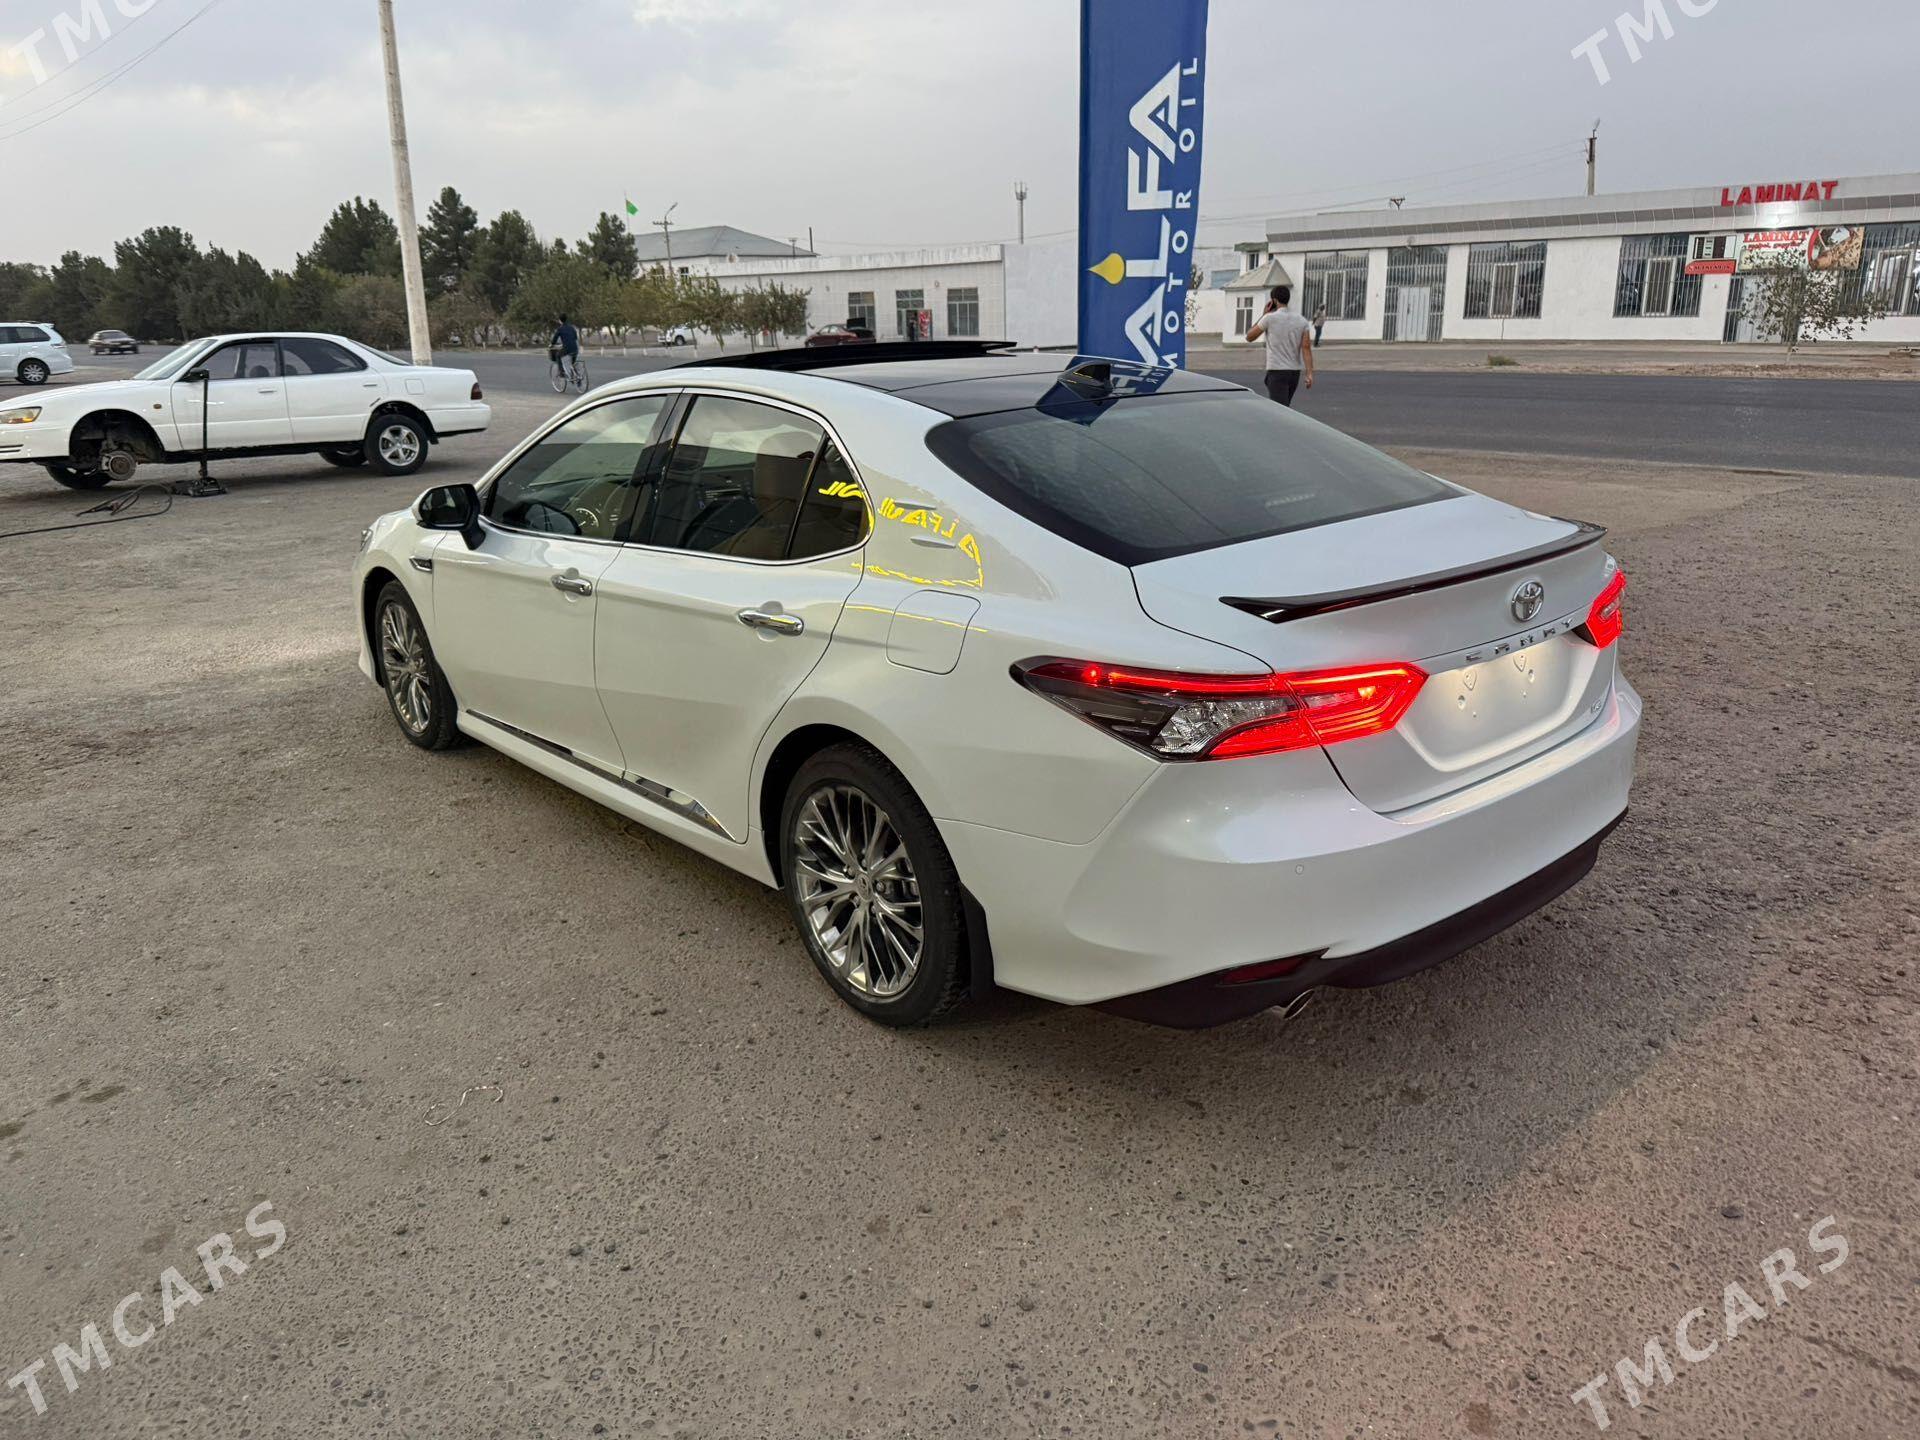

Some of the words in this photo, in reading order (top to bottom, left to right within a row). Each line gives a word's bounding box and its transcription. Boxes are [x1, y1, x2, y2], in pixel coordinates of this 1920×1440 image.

[1124, 61, 1181, 368] ALFA
[1161, 189, 1193, 369] MOTOR
[1178, 57, 1198, 153] OIL
[1720, 180, 1839, 207] LAMINAT
[1743, 230, 1811, 244] LAMINAT
